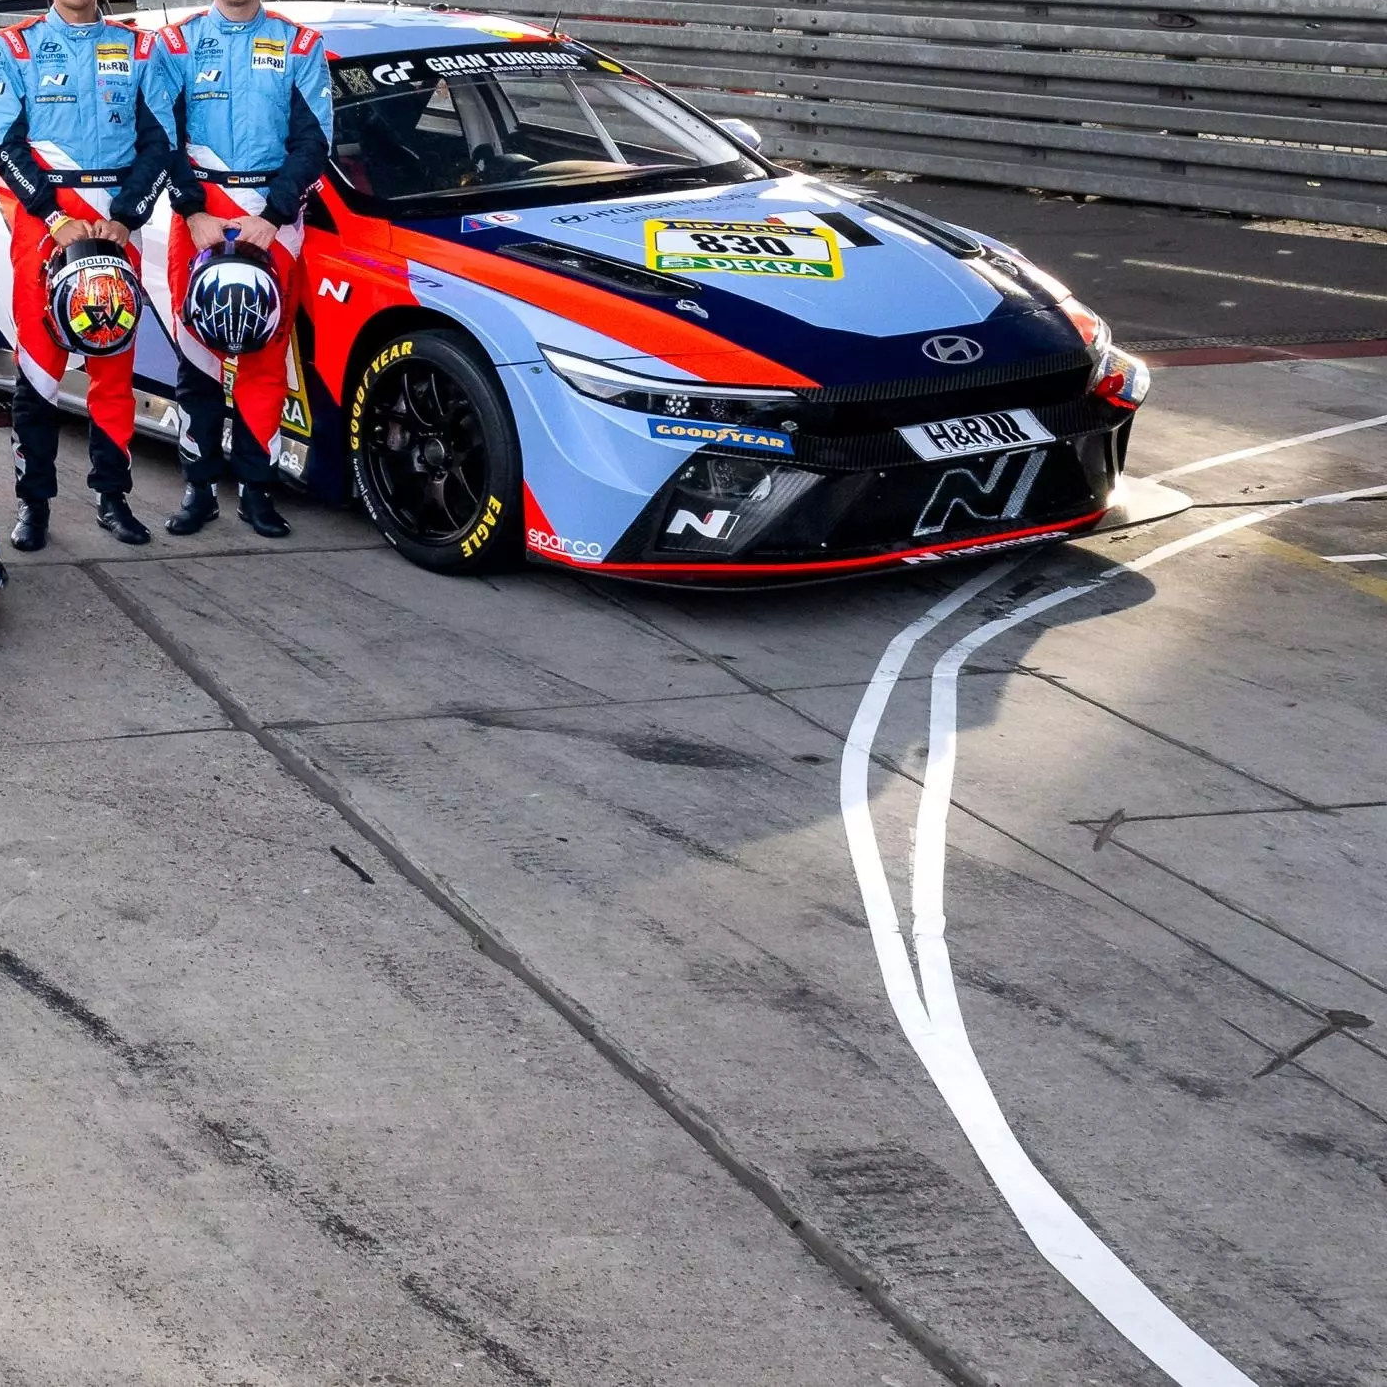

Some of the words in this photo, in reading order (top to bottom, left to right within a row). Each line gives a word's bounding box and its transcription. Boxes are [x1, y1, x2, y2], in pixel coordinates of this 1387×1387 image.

[98, 62, 119, 72] H&R
[252, 55, 273, 65] H&R
[425, 54, 486, 72] GRAN
[439, 70, 457, 78] THE
[458, 67, 489, 77] REAL
[489, 65, 530, 73] DRIVING
[531, 64, 588, 72] SIMULATOR
[7, 158, 37, 196] HYUNDAI
[592, 198, 680, 219] HYUNDAI
[675, 220, 811, 236] RAVENOL
[690, 233, 796, 257] 830
[703, 257, 825, 277] DEKRA
[317, 277, 354, 304] N
[350, 341, 414, 451] GOODYEAR
[655, 422, 787, 450] GOODYEAR
[925, 419, 993, 453] H&R
[459, 494, 503, 559] EAGLE
[526, 526, 604, 556] sparco
